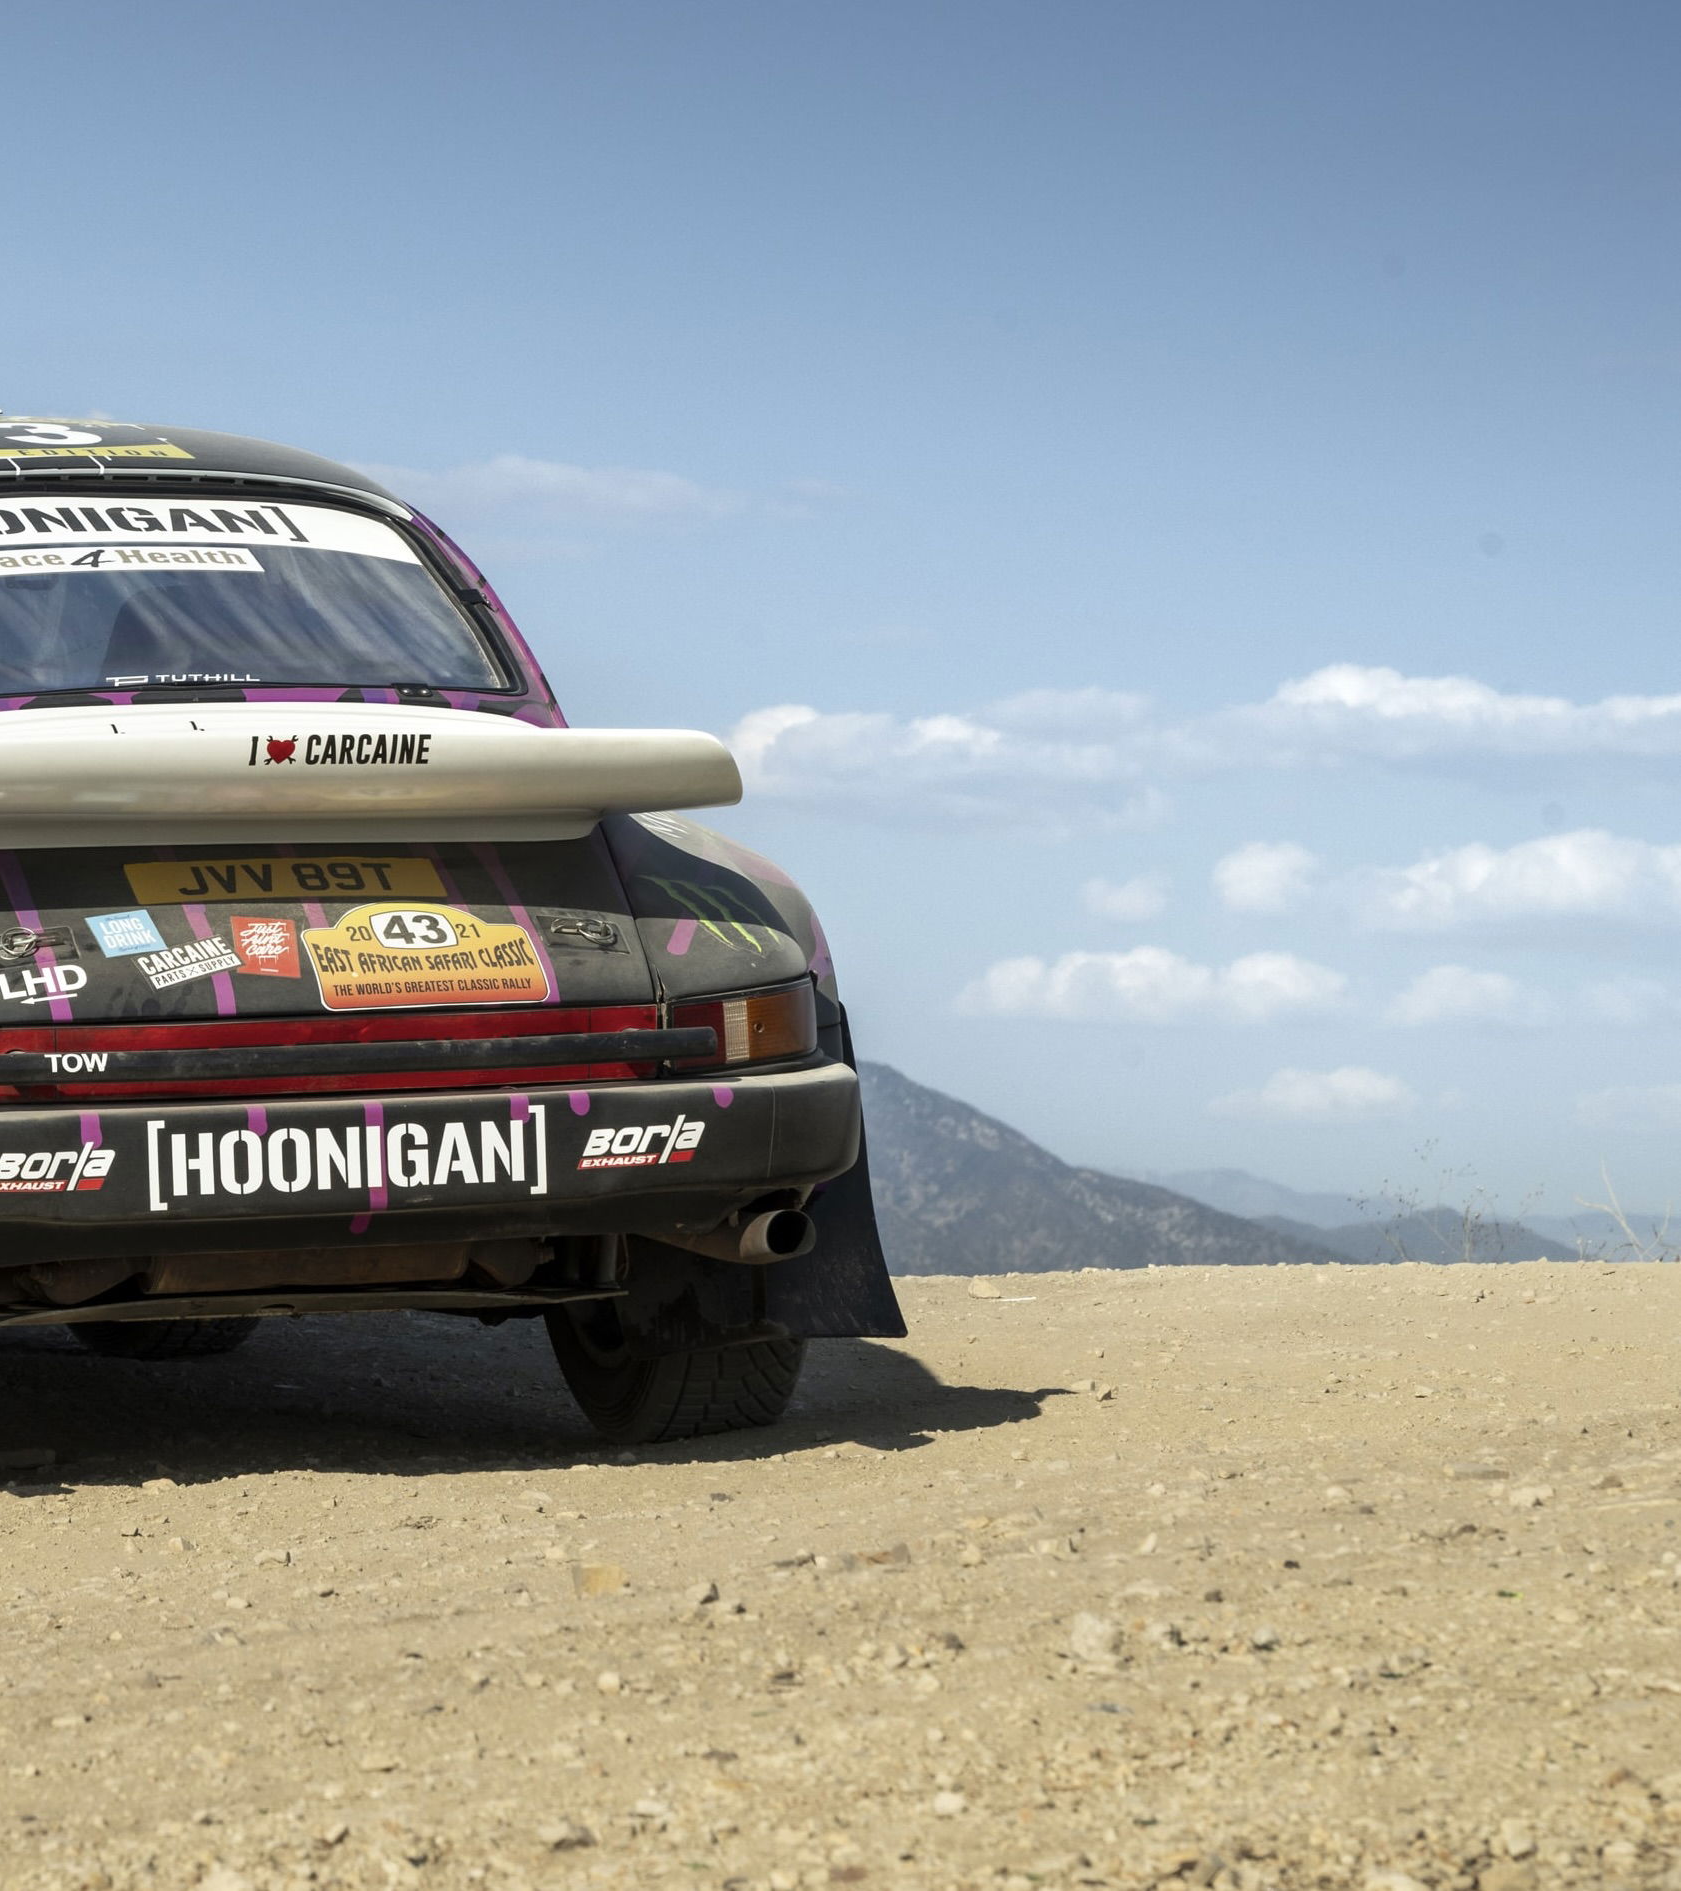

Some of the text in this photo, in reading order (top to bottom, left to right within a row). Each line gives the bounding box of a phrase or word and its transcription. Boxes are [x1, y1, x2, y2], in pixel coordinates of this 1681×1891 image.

[18, 447, 169, 458] EDITION
[70, 550, 113, 568] 4
[114, 549, 247, 566] Health
[155, 674, 261, 683] TUTHILL
[248, 734, 432, 766] I CARCAINE
[178, 862, 392, 896] JVV 89T
[99, 917, 143, 934] LONG
[346, 926, 372, 942] 20
[383, 914, 448, 945] 43
[455, 923, 480, 938] 21
[103, 929, 157, 949] DRINK
[137, 936, 233, 975] CARCAINE
[312, 937, 534, 977] EAST AFRICAN SAFARI CLASSIC
[155, 956, 236, 986] PARTS SUPPLY
[333, 977, 532, 997] THE WORLD'S GREATEST CLASSIC RALLY
[44, 1053, 108, 1073] TOW
[581, 1155, 657, 1168] EXHAUST
